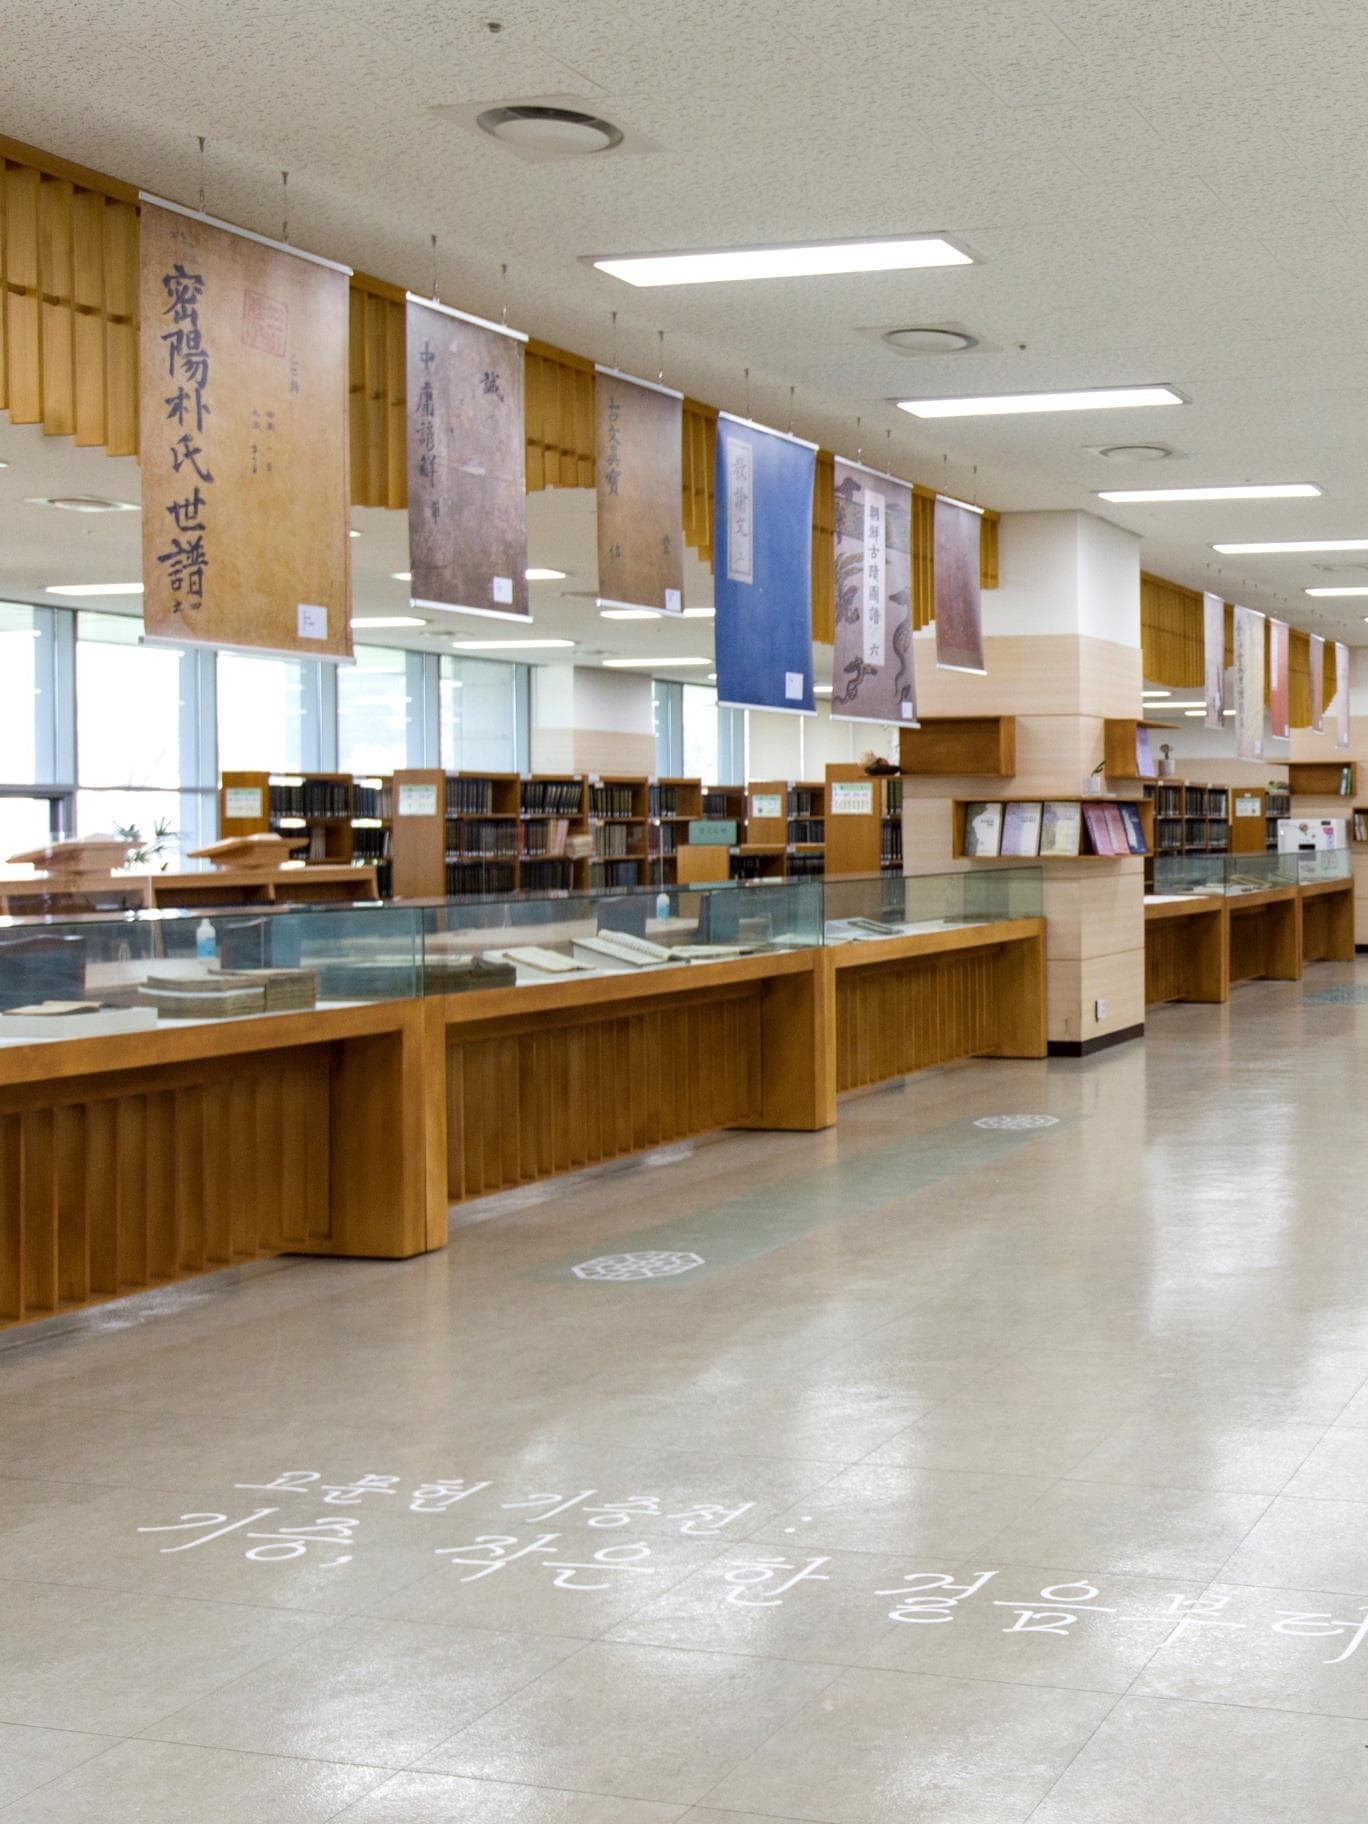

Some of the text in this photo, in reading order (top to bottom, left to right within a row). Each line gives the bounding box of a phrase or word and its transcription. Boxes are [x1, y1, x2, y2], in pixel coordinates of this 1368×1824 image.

[234, 1470, 755, 1536] 고문헌 기증전
[137, 1507, 354, 1568] 기증,
[435, 1532, 654, 1590] 작은
[723, 1556, 830, 1606] 한
